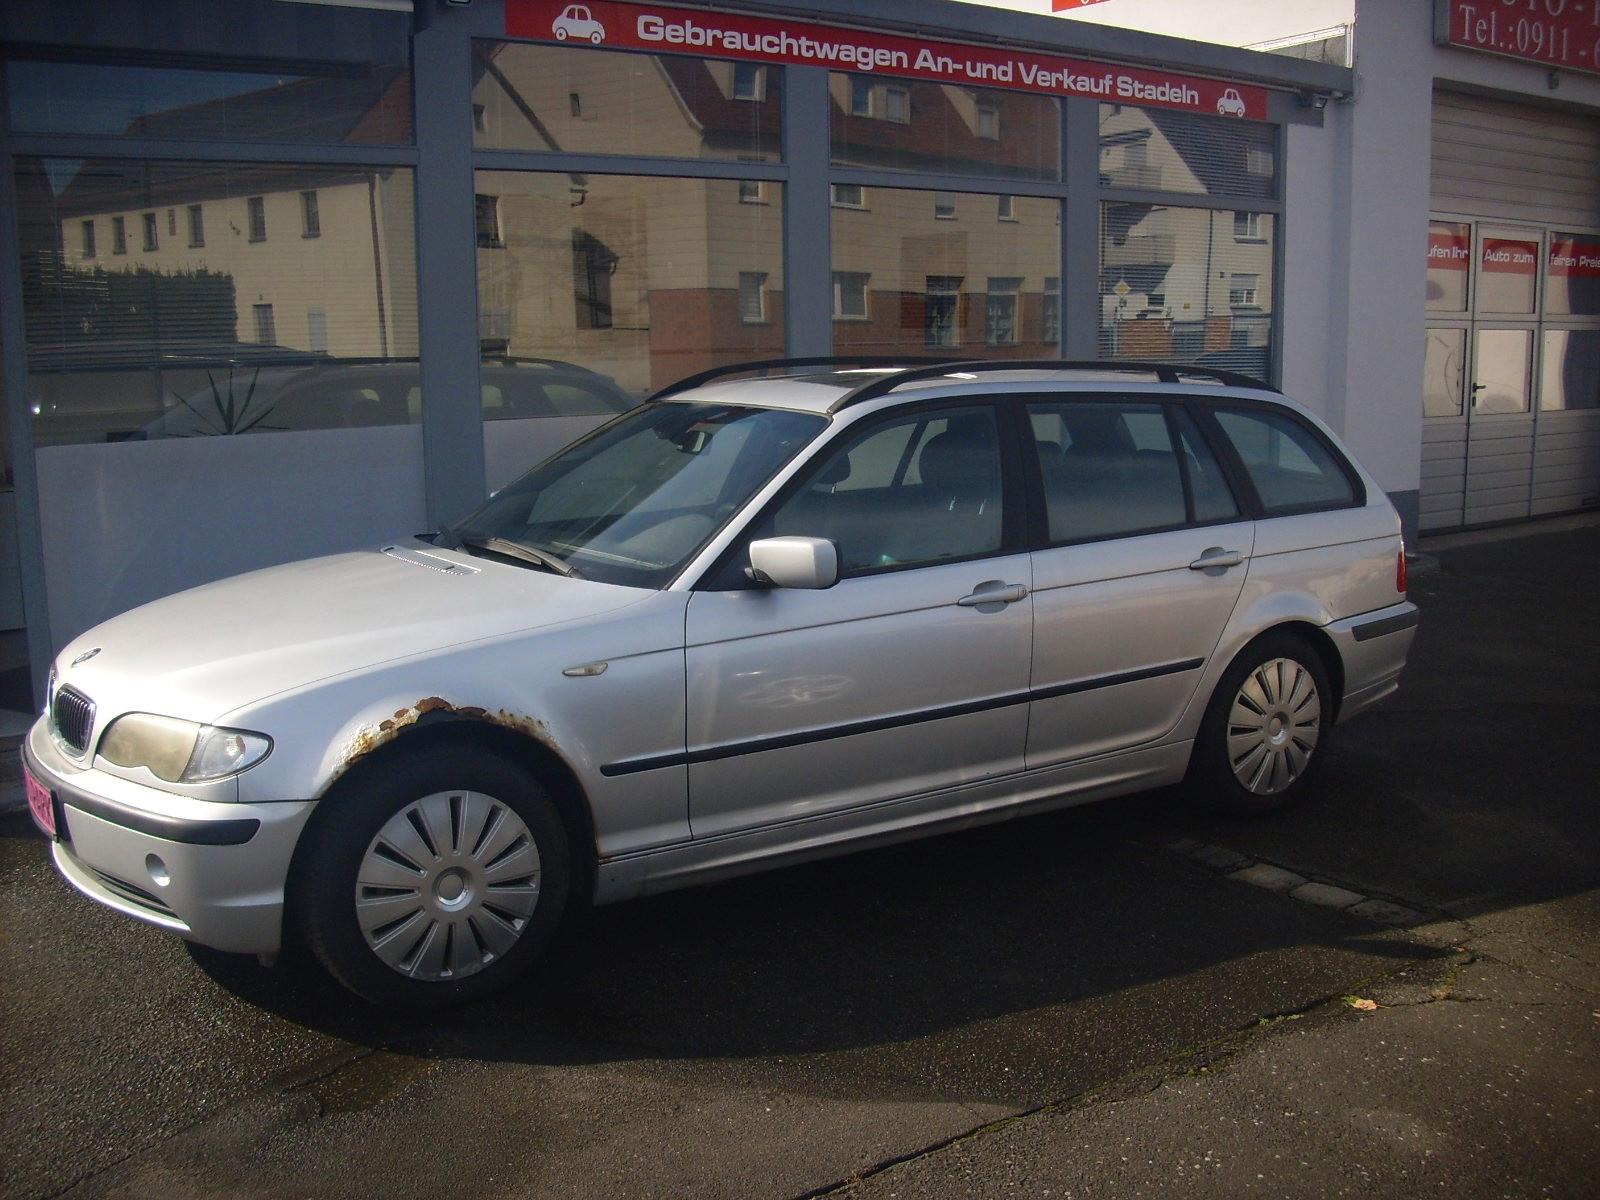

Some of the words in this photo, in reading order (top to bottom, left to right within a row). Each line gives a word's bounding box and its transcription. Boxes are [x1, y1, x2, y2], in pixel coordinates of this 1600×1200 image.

[636, 14, 908, 72] Gebrauchtwagen
[1018, 61, 1114, 95] Verkauf
[1116, 75, 1200, 106] Stadeln
[1452, 245, 1469, 259] Ihr
[1484, 248, 1510, 262] Auto
[1512, 253, 1534, 264] zum
[1550, 254, 1577, 267] fairen
